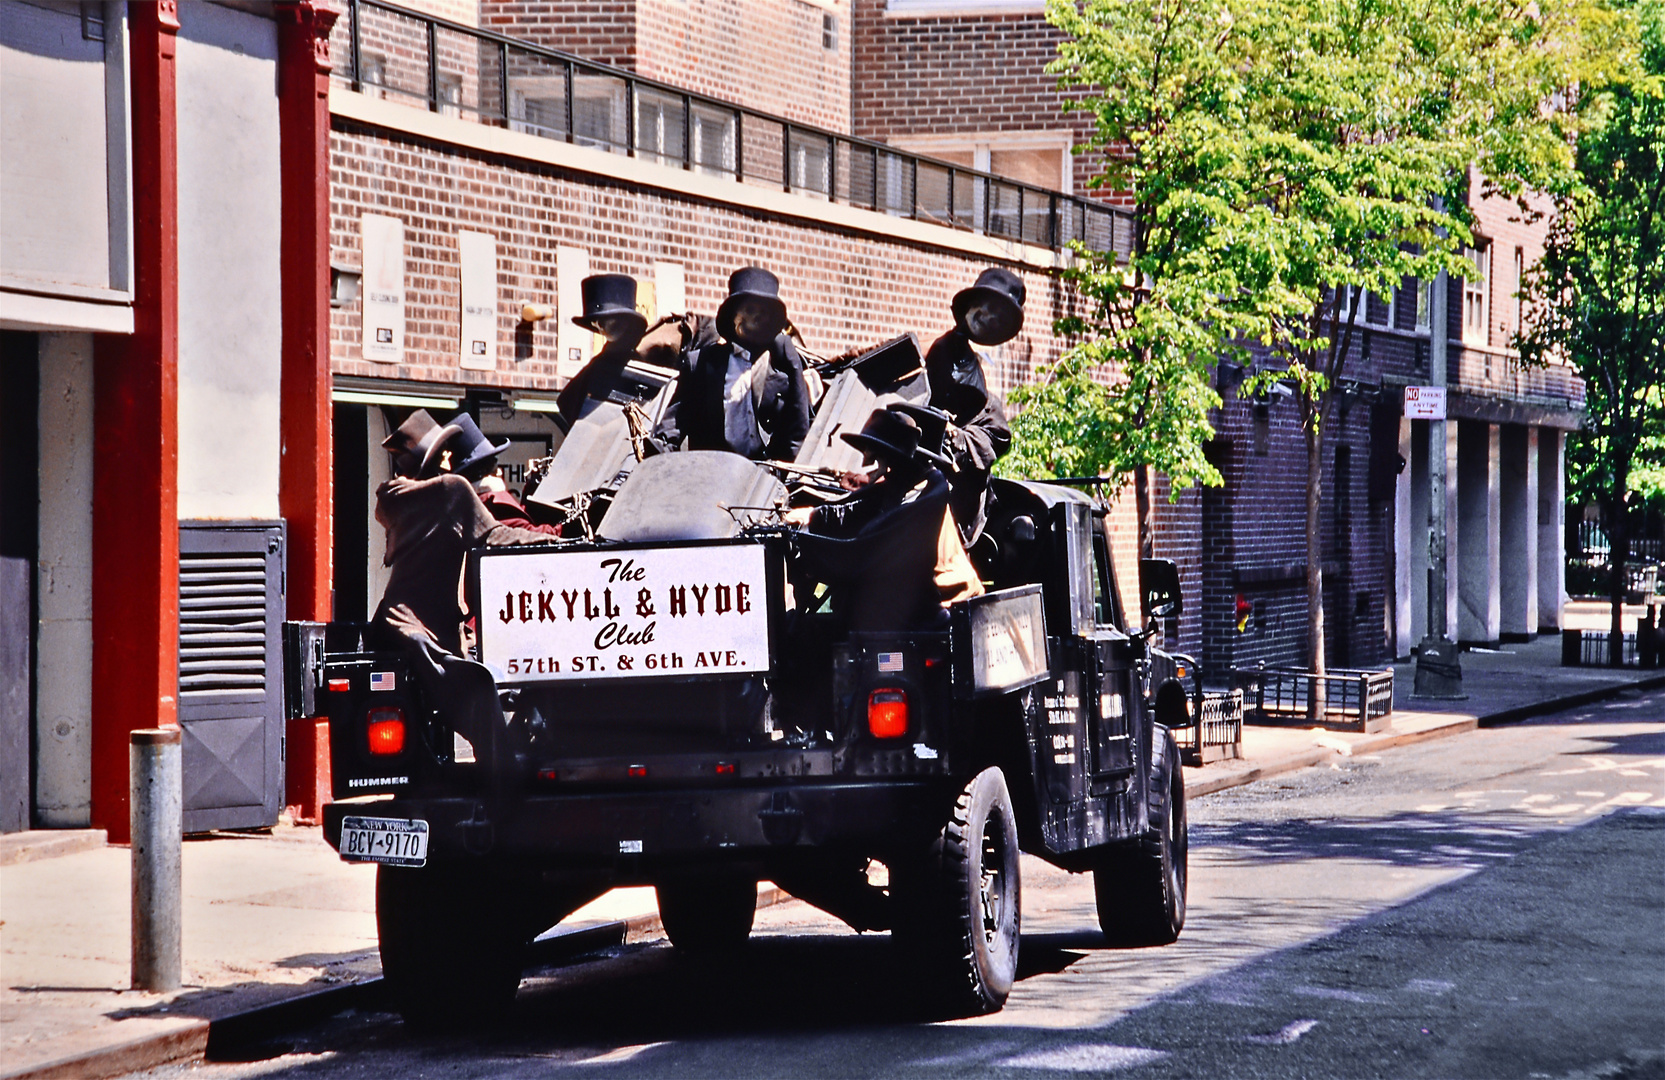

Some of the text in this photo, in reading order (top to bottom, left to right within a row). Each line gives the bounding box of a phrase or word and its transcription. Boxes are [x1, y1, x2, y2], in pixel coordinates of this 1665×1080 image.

[1407, 388, 1419, 400] NO
[600, 558, 646, 583] The
[499, 581, 751, 624] JEKYLL & HYDE
[594, 621, 656, 650] Club
[507, 650, 746, 675] 57th ST. & 6th AVE.
[348, 776, 409, 788] HUMMER
[364, 820, 407, 832] NEW YORK
